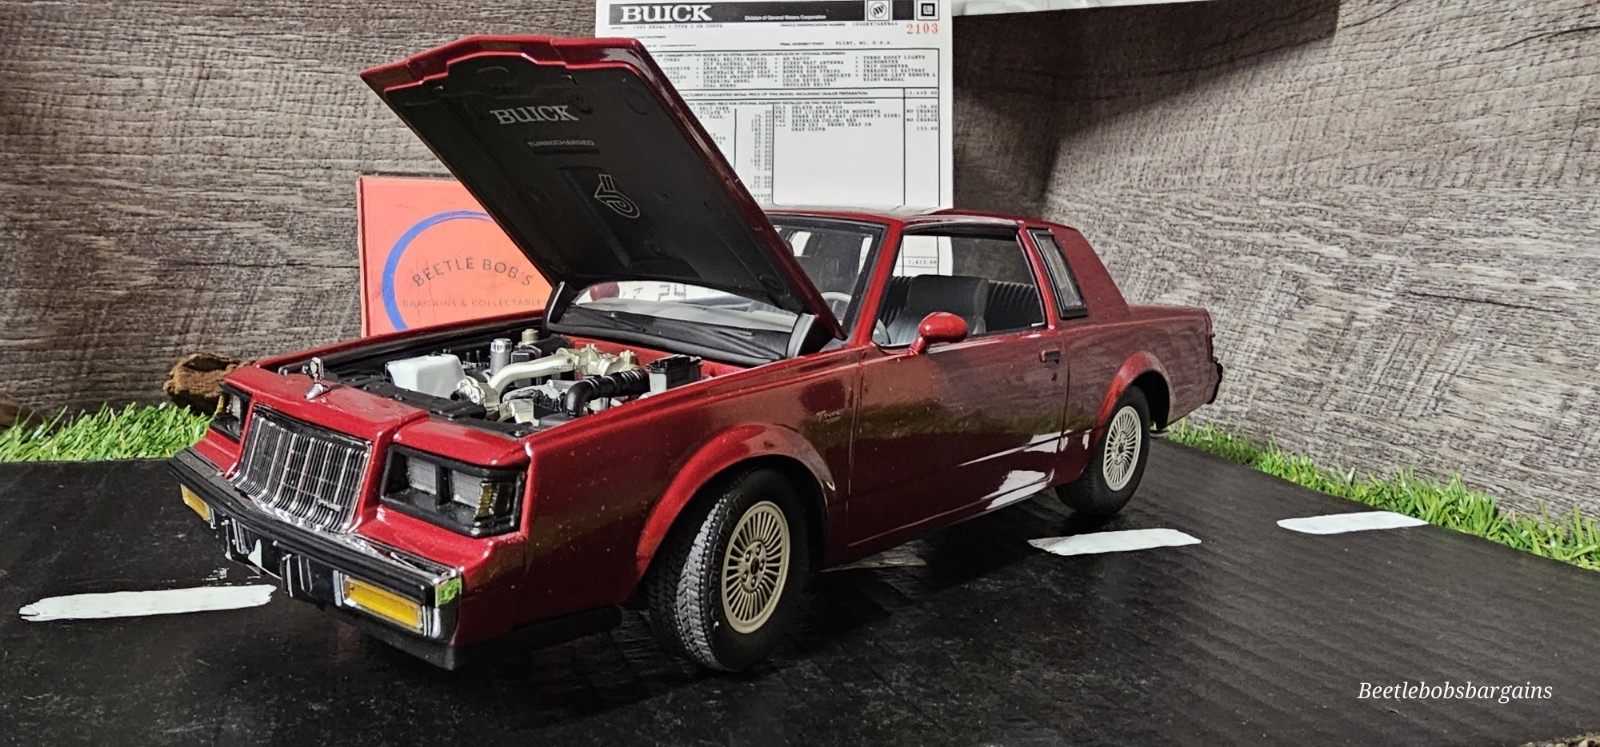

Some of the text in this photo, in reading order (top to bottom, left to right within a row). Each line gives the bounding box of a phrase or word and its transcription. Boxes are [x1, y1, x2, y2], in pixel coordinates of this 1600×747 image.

[620, 4, 713, 23] BUICK
[907, 24, 939, 34] 2103
[490, 104, 580, 124] BUICK
[528, 140, 596, 148] TURBOCHARGED
[412, 257, 534, 287] BEETLE BOB'S
[402, 299, 457, 308] BARGAINS
